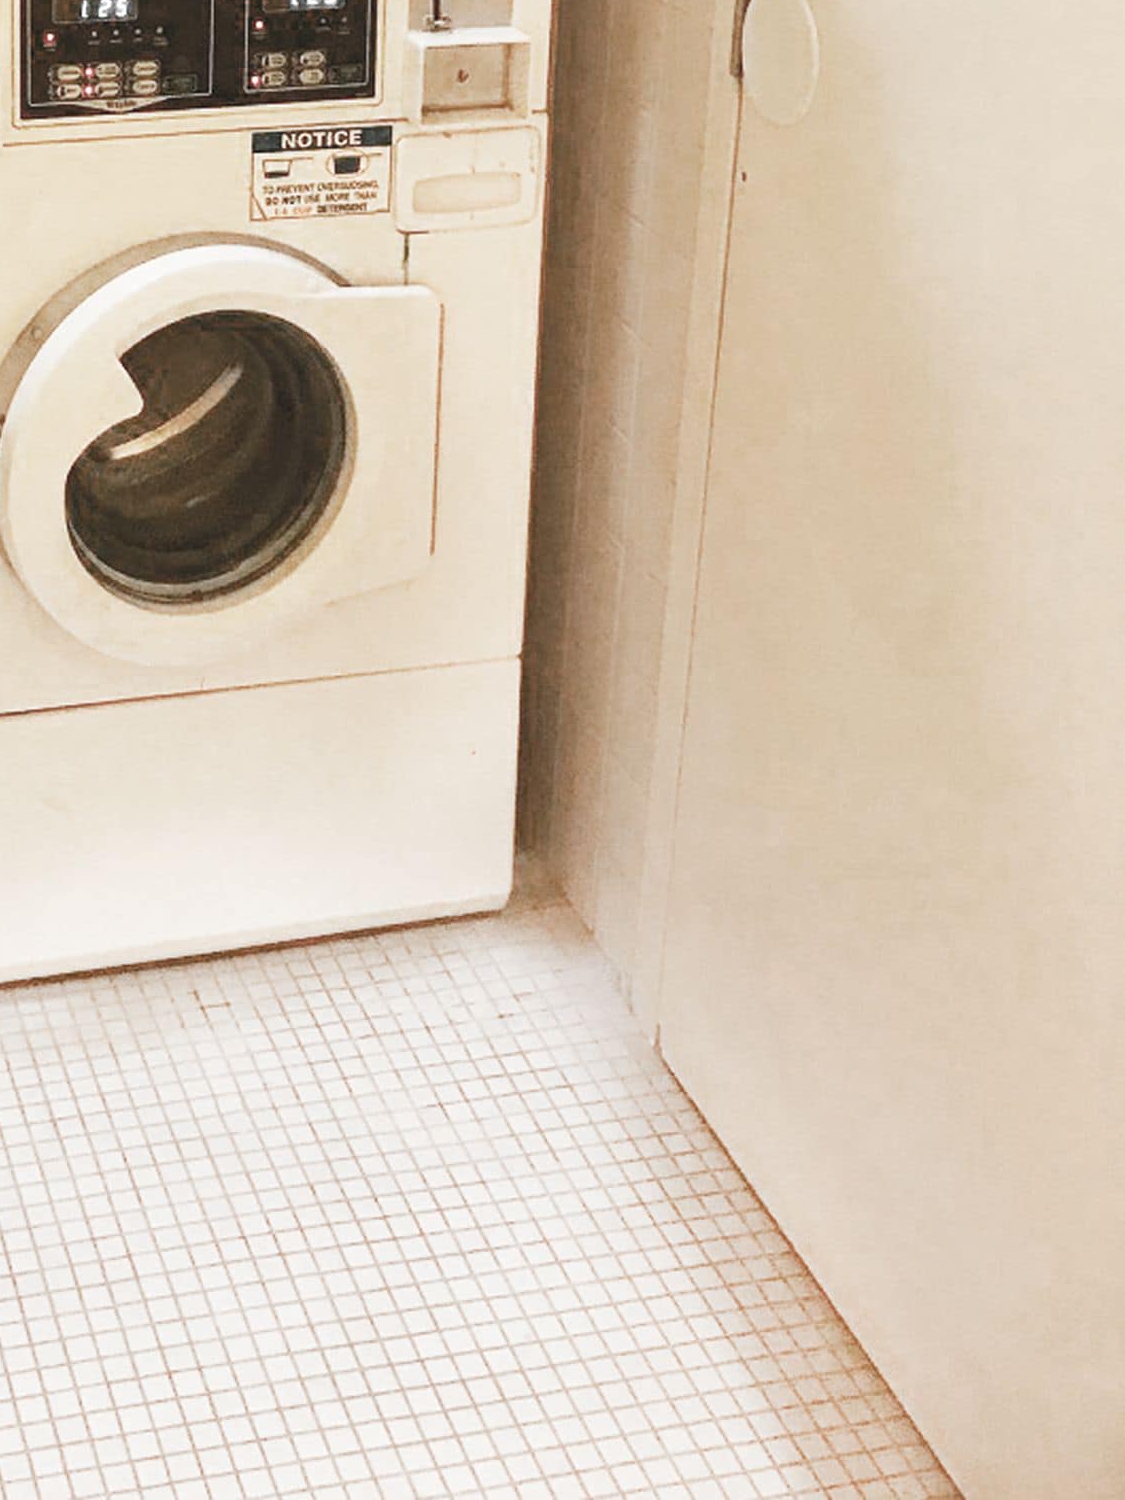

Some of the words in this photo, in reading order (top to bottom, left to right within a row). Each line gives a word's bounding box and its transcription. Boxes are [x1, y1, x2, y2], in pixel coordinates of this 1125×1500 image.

[281, 129, 363, 149] NOTICE
[276, 183, 314, 194] PREVENT
[265, 197, 279, 206] DO
[281, 195, 301, 204] NOT
[325, 192, 349, 201] MORE
[355, 191, 377, 199] THAN
[317, 202, 368, 213] DETERGENT
